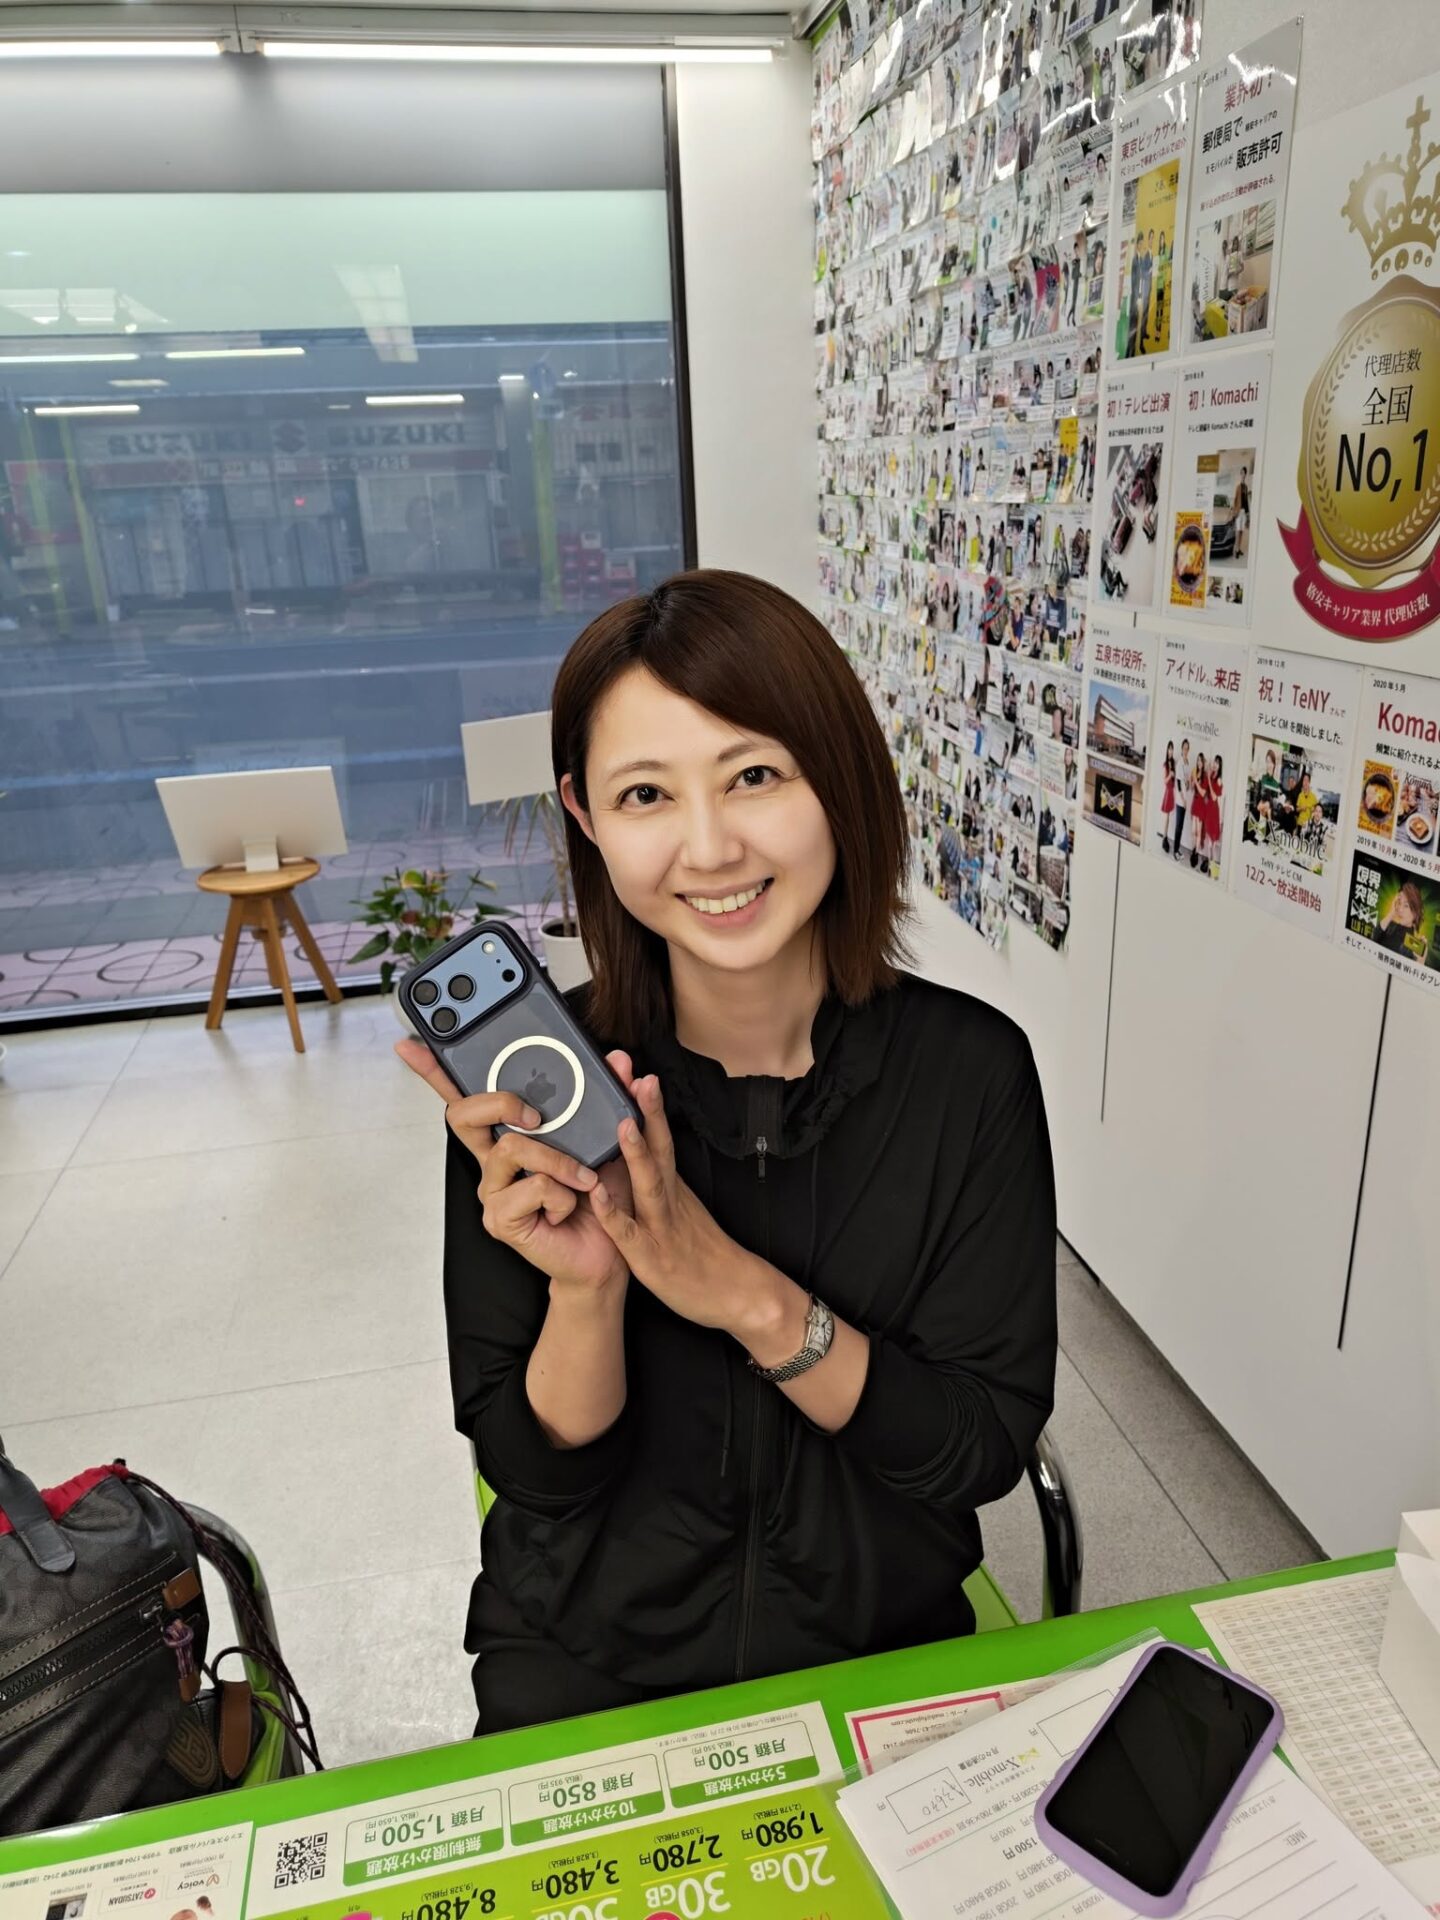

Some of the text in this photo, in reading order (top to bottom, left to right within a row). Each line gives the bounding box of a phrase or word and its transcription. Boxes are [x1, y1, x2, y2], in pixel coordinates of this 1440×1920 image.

[1202, 116, 1243, 153] 郵便局で
[1235, 131, 1283, 171] 販売許可
[1365, 348, 1422, 378] 代理店数
[1211, 381, 1260, 407] Komachi
[1362, 384, 1413, 426] 全国
[328, 423, 465, 446] SUZUKI
[1336, 429, 1428, 503] No,1
[1306, 582, 1431, 626] 格安キャリア業界 代理店数
[1258, 676, 1284, 703] 祝！
[1028, 1727, 1038, 1736] 円
[755, 1738, 785, 1758] 月額
[602, 1771, 634, 1793] 月額
[703, 1765, 787, 1797] 5分かけ放題
[451, 1805, 485, 1828] 月額
[542, 1800, 637, 1834] 10分かけ放題
[876, 1801, 886, 1811] 円
[365, 1835, 482, 1877] 無制限かけ放題
[1002, 1836, 1038, 1860] 1500円
[750, 1845, 836, 1893] 20GB
[108, 1891, 143, 1906] ZATSUDAN
[177, 1879, 204, 1891] voicy
[645, 1871, 731, 1919] 30GB
